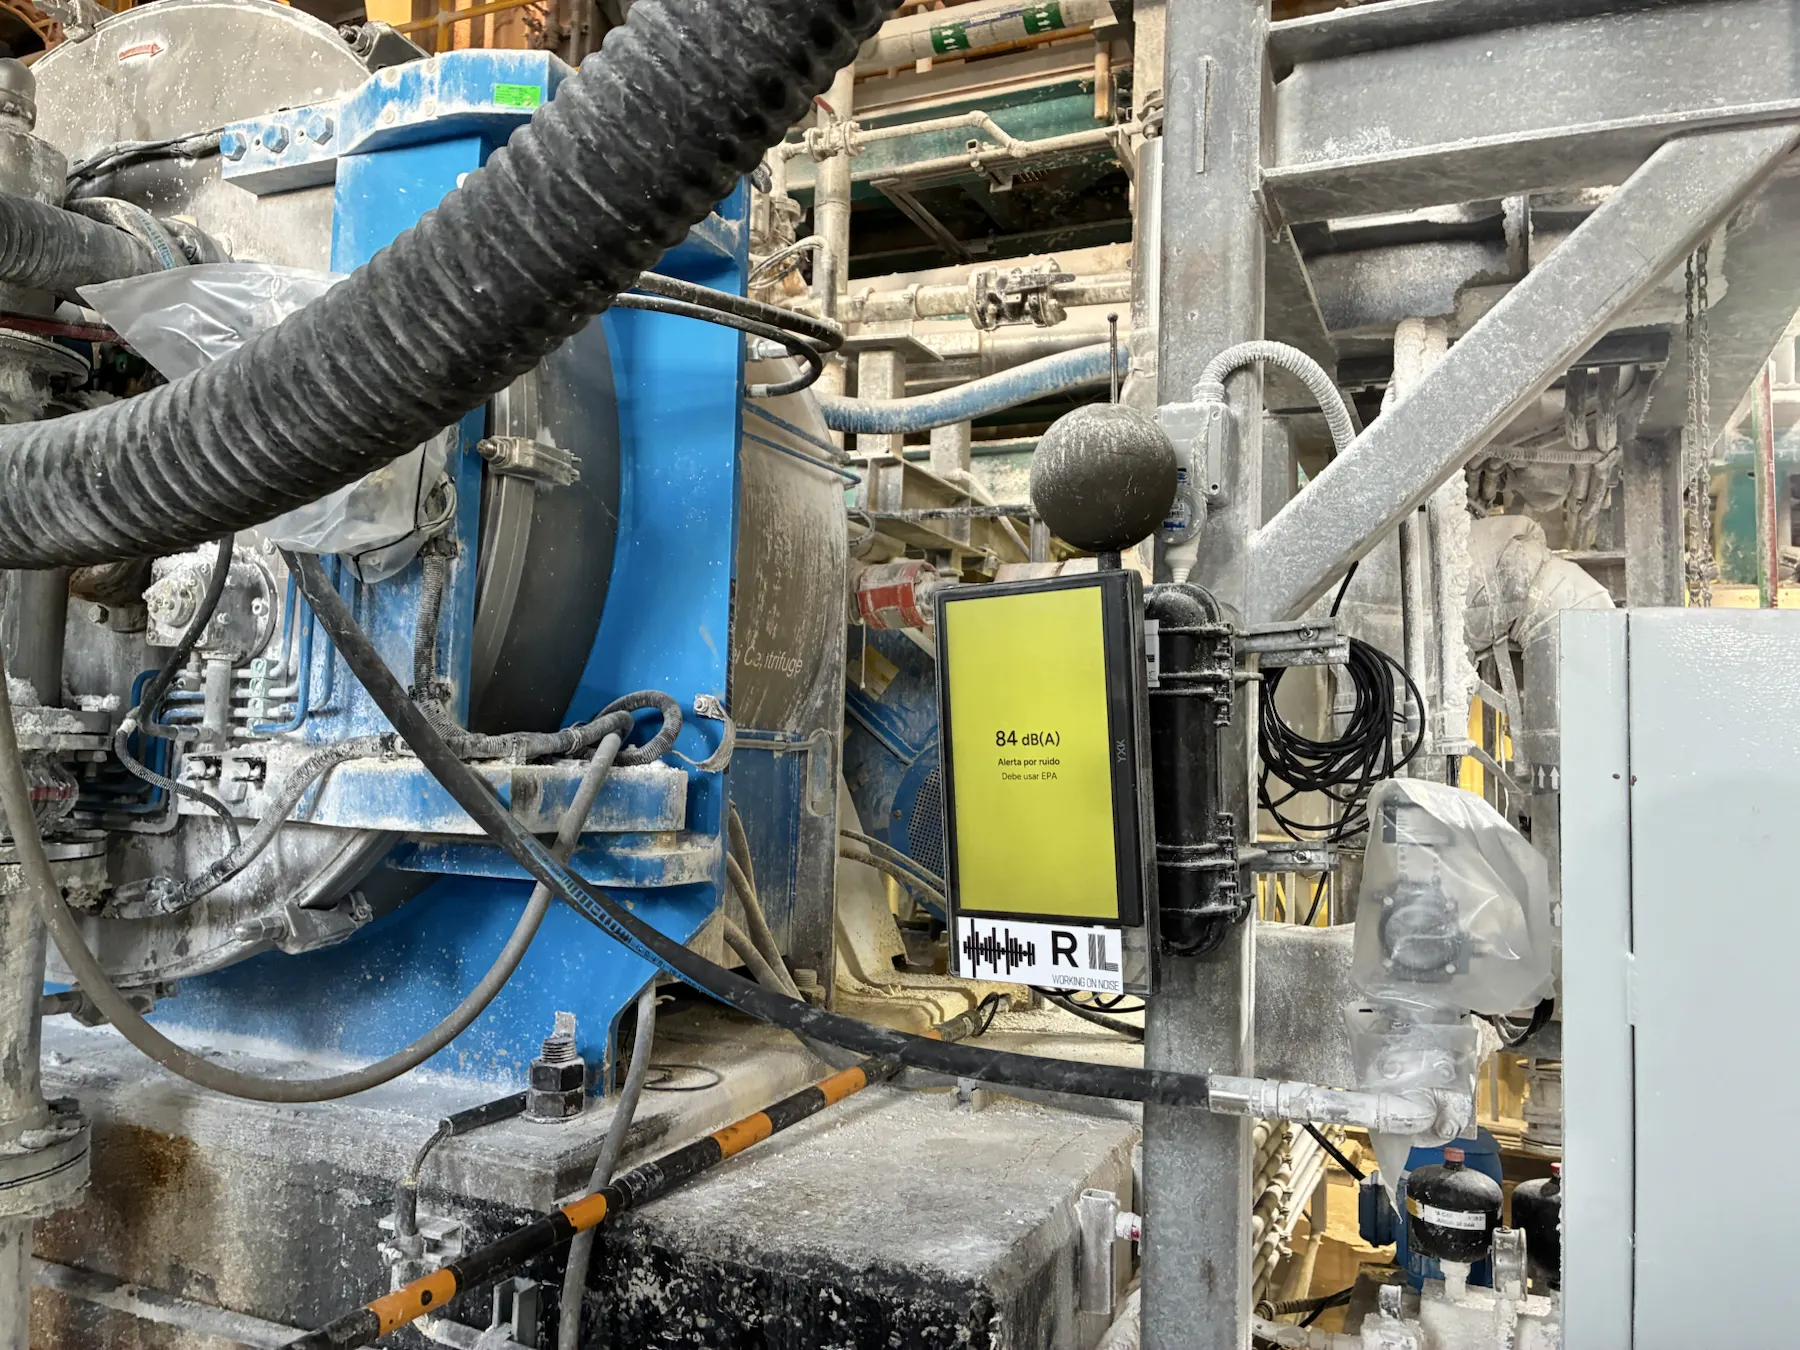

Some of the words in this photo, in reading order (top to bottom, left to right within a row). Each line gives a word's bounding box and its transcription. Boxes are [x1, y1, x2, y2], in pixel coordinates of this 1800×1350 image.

[995, 730, 1018, 747] 84
[1021, 731, 1060, 747] dB(A)
[1116, 739, 1127, 763] YXK
[998, 758, 1021, 766] Alerta
[1023, 759, 1037, 768] por
[1039, 757, 1060, 766] ruido
[1001, 772, 1022, 780] Debe
[1041, 771, 1058, 780] EPA
[1051, 974, 1086, 988] WORKING
[1086, 978, 1097, 989] ON
[1098, 979, 1120, 991] NOISE
